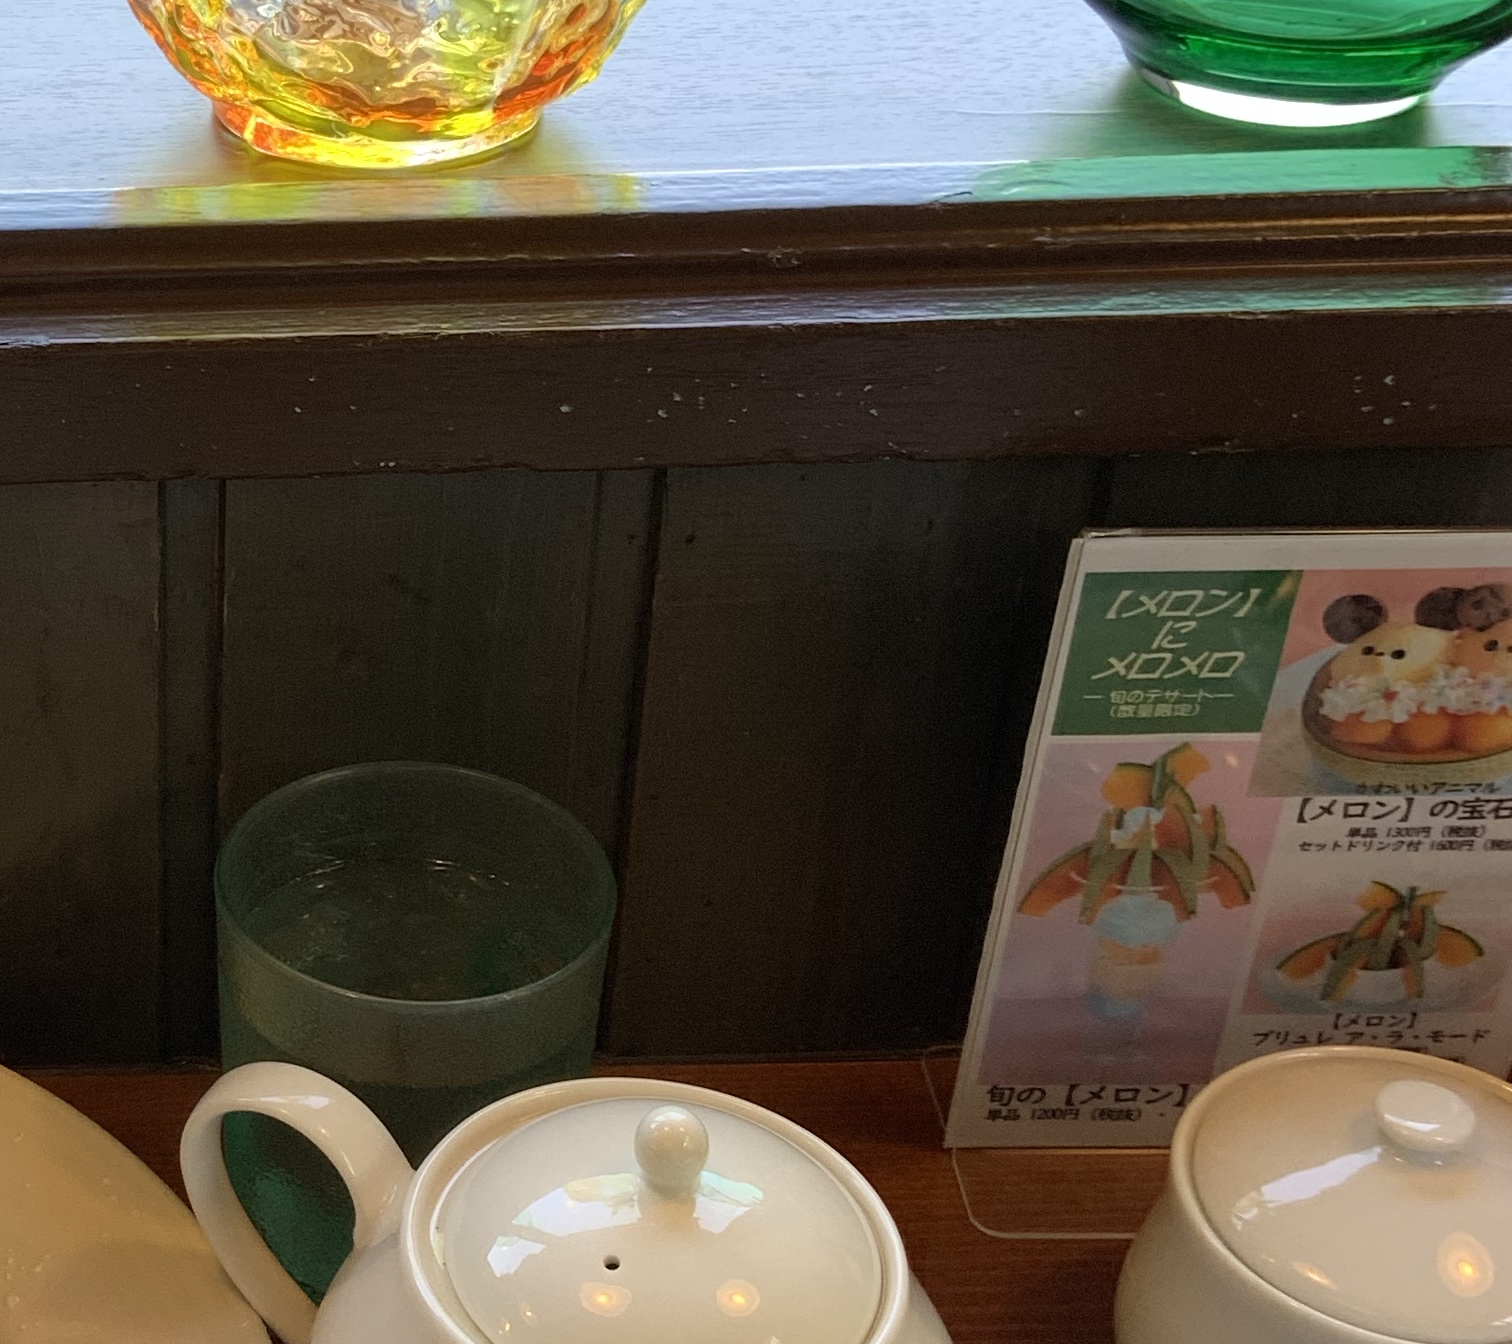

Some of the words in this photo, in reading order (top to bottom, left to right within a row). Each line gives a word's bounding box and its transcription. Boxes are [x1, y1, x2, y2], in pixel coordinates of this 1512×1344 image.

[1104, 587, 1263, 620] 【メロン】
[1150, 619, 1198, 650] に
[1090, 650, 1246, 681] メロメロ
[1332, 1011, 1418, 1030] 【メロン】
